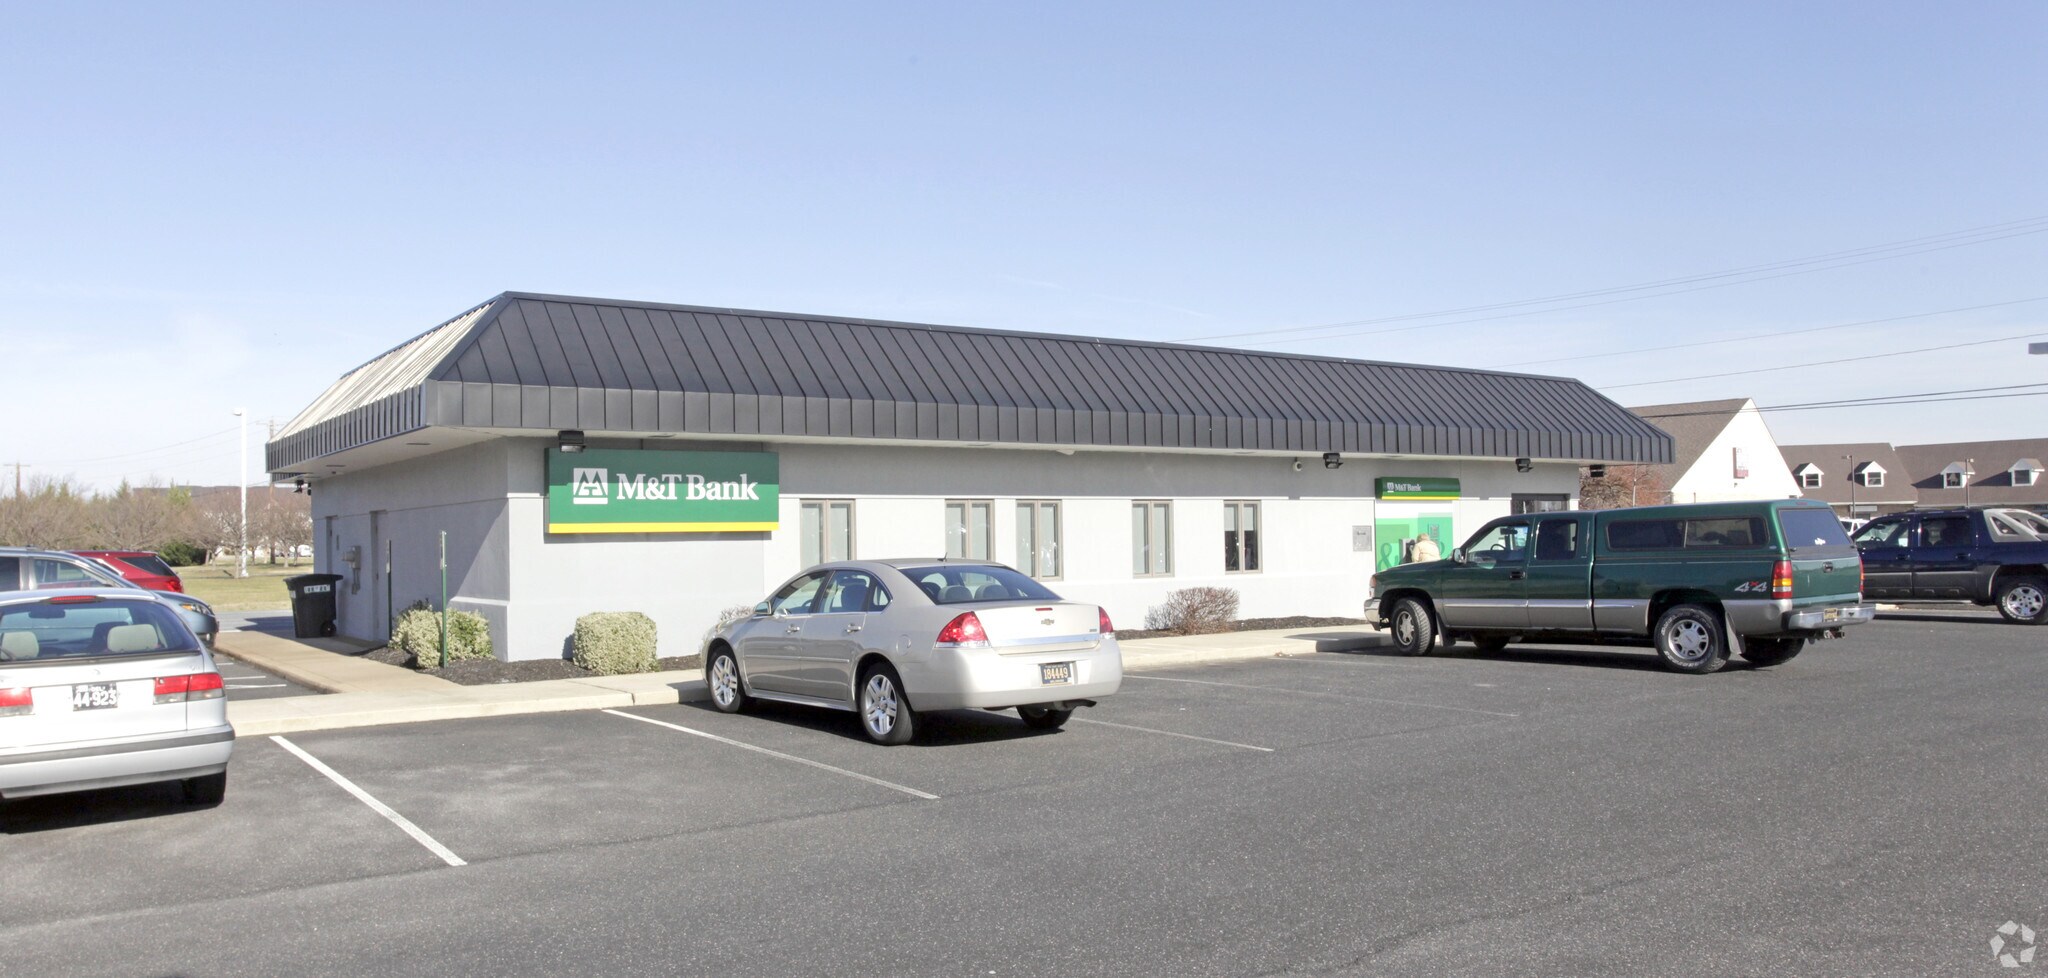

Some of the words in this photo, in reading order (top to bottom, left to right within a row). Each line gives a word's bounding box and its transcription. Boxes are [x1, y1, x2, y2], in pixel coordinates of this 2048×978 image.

[616, 473, 682, 500] M&T
[685, 473, 759, 500] Bank
[1394, 483, 1407, 491] M&T
[1407, 483, 1421, 491] Bank
